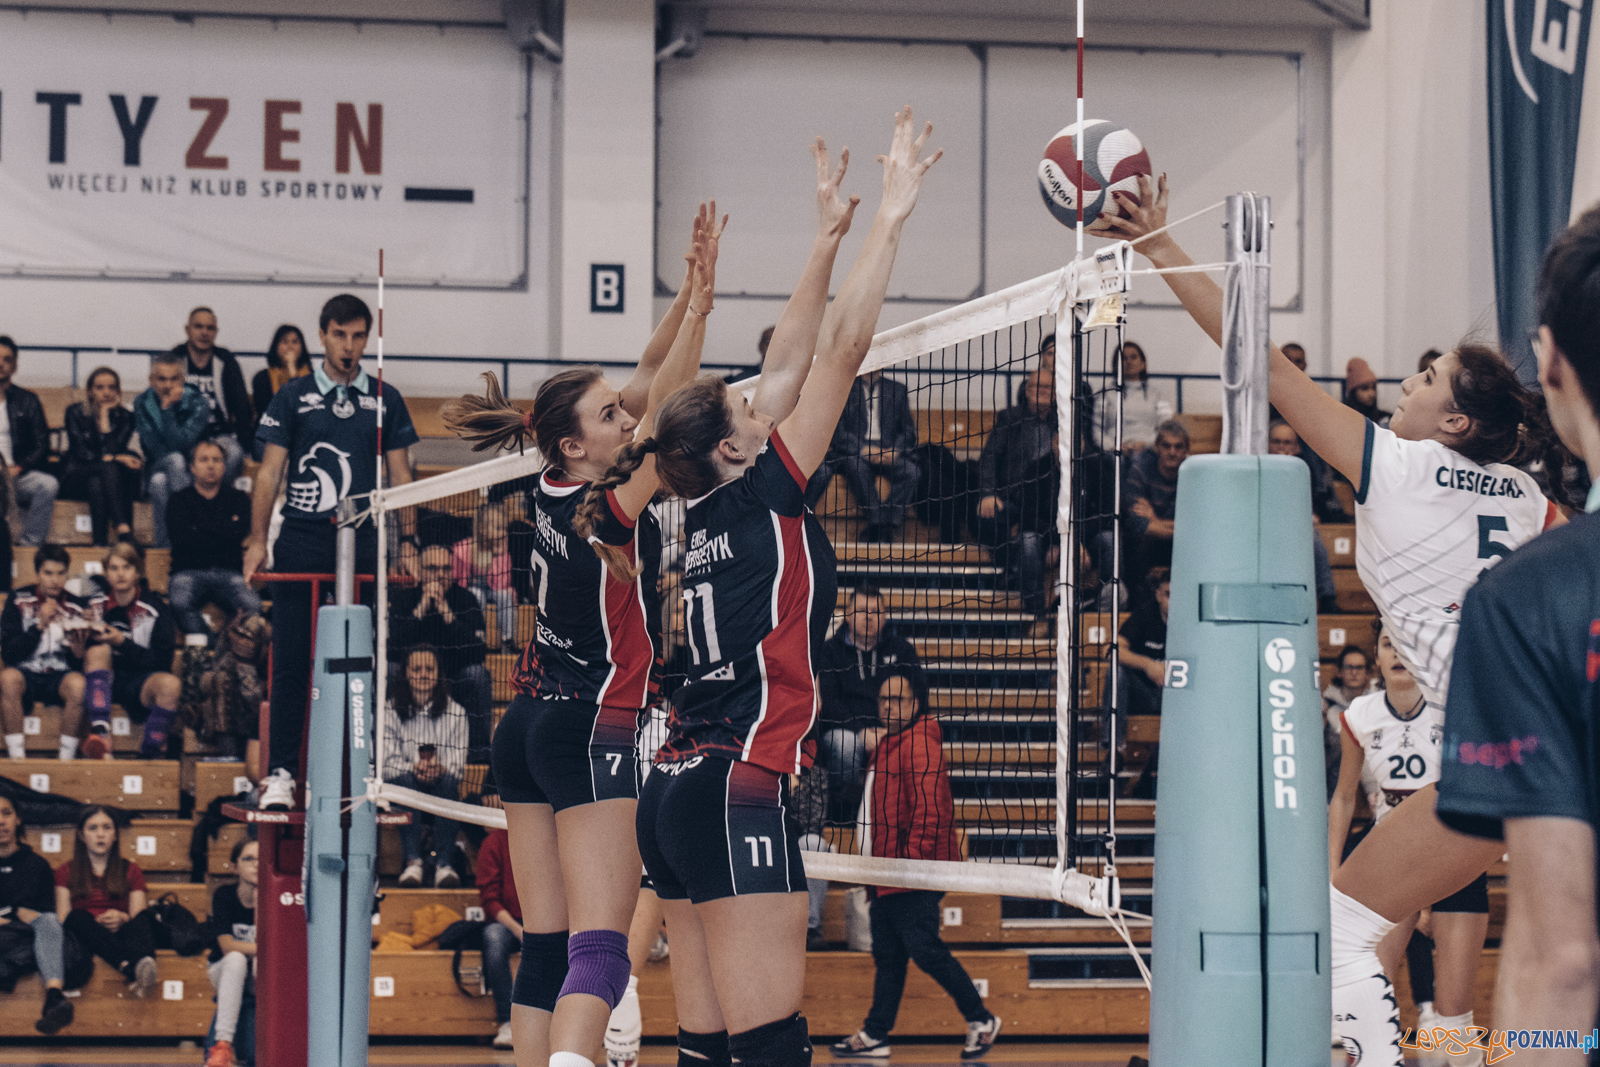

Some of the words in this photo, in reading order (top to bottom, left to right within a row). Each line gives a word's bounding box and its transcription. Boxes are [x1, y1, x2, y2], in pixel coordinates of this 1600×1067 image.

[0, 91, 384, 176] TYZEN
[49, 173, 127, 195] WIĘCEJ
[191, 179, 247, 197] KLUB
[261, 181, 382, 200] SPORTOWY
[1045, 164, 1073, 206] molten
[596, 270, 619, 306] B
[531, 549, 548, 618] 7
[682, 582, 722, 666] 11
[352, 695, 365, 749] Senoh
[1269, 679, 1298, 809] Senoh
[606, 753, 622, 776] 7
[1388, 754, 1426, 779] 20
[256, 812, 289, 823] Senoh
[745, 836, 773, 867] 11
